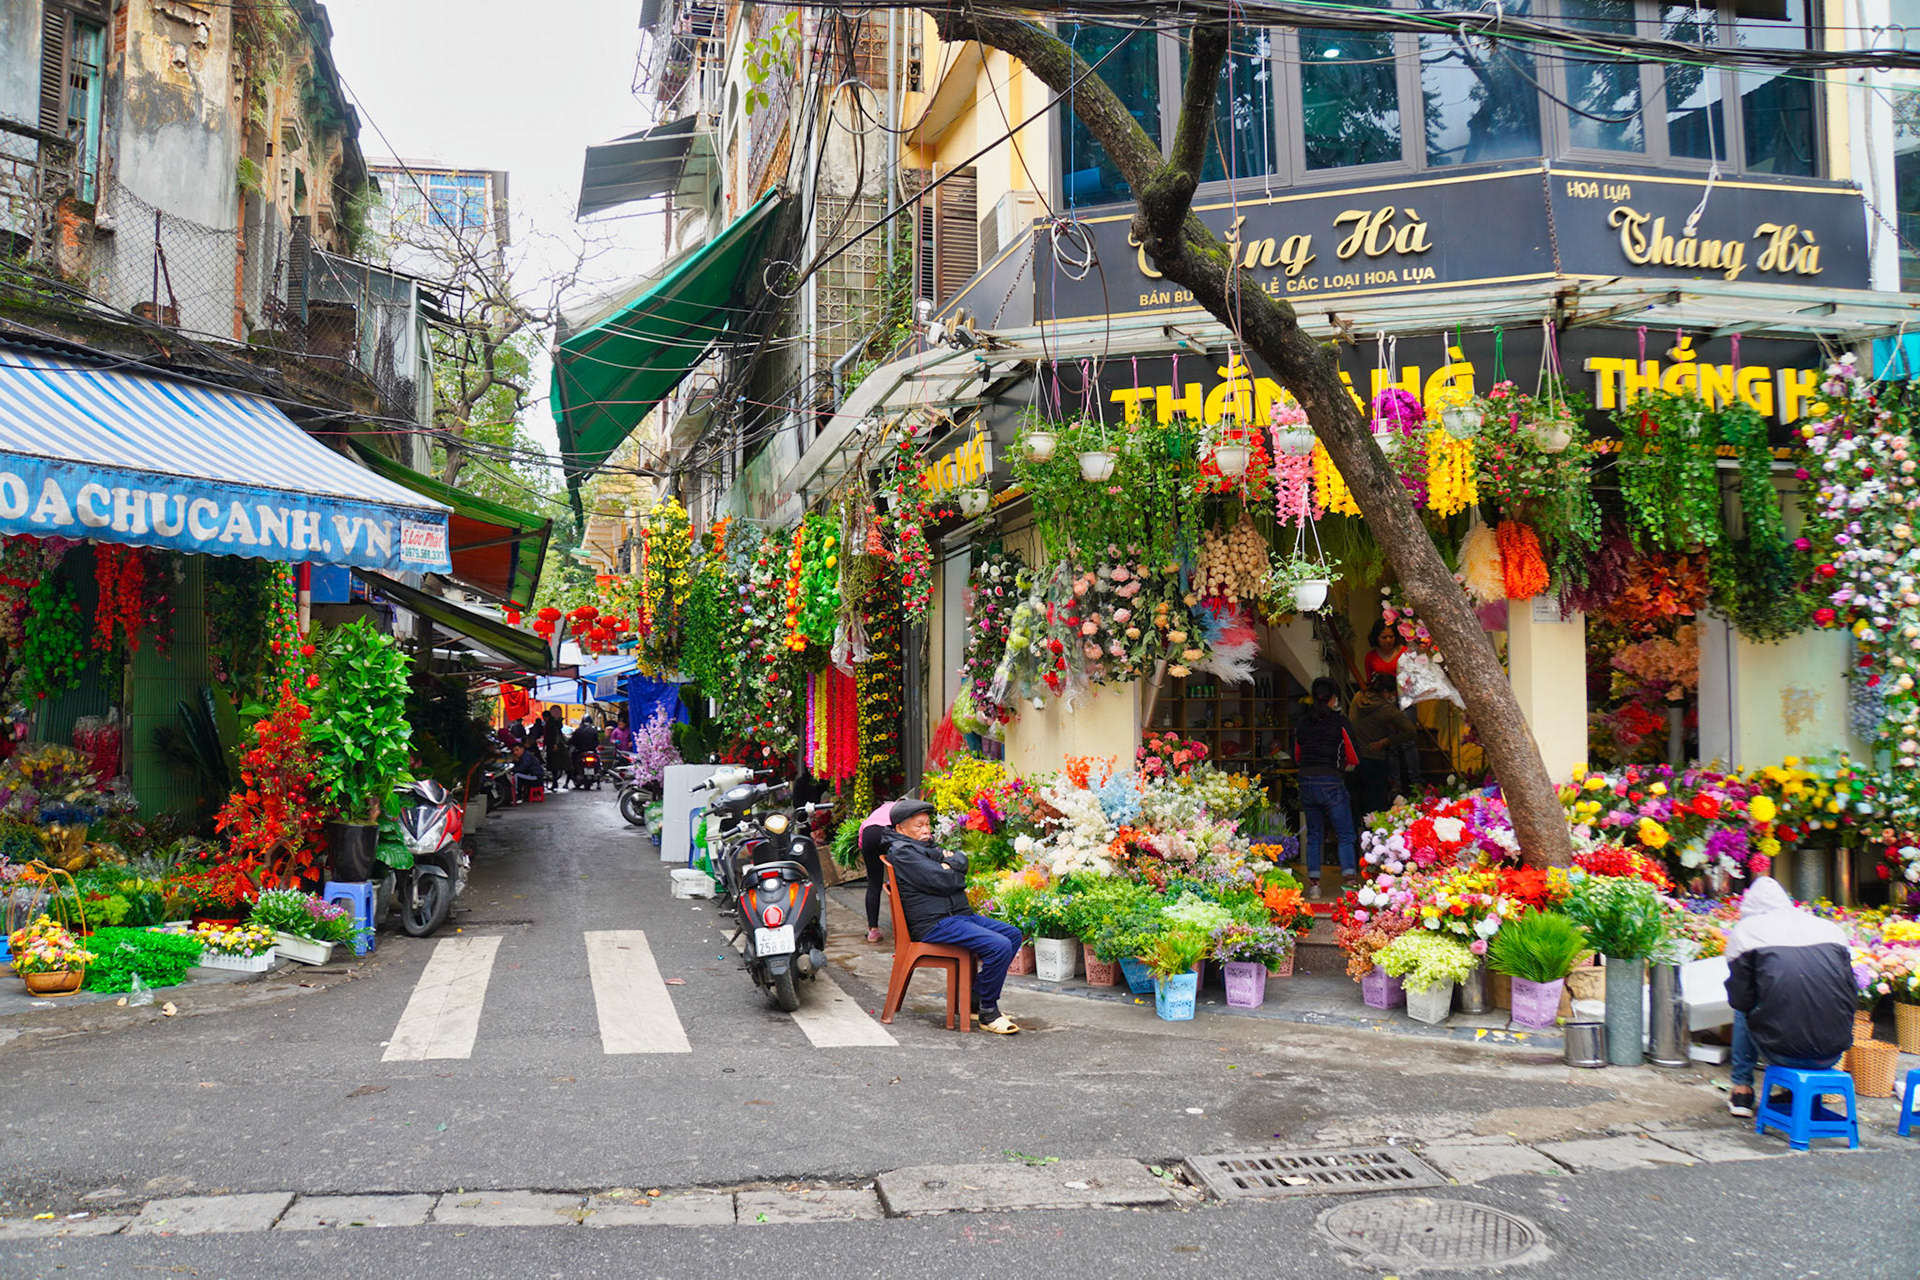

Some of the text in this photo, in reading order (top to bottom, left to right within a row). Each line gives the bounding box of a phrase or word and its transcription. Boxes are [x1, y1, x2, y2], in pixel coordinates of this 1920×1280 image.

[1566, 180, 1632, 204] HOA LỤA
[1332, 205, 1433, 260] Hà
[1752, 222, 1824, 276] Hà
[1138, 288, 1171, 307] BÁN
[1285, 274, 1319, 294] CÁC
[1323, 270, 1360, 292] LOẠI
[1364, 267, 1398, 284] HOA
[1401, 264, 1436, 286] LỤA
[1584, 336, 1818, 425] THẮNG H
